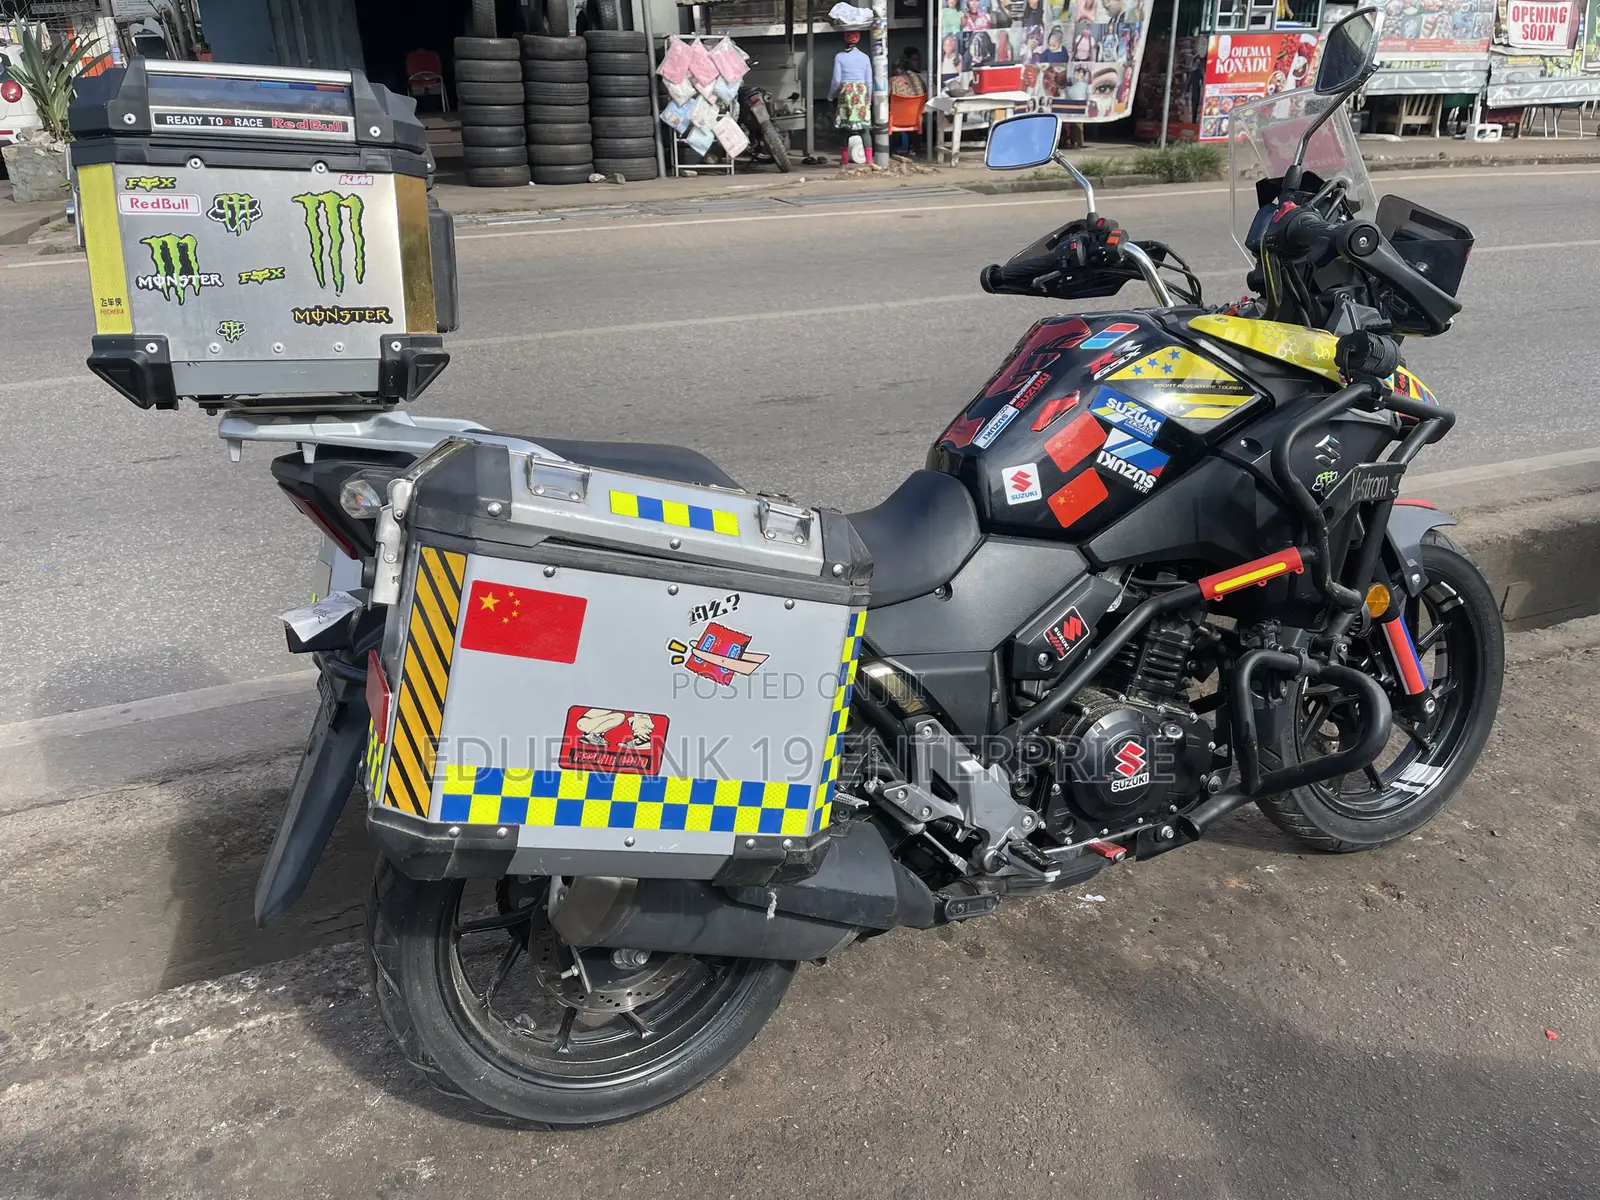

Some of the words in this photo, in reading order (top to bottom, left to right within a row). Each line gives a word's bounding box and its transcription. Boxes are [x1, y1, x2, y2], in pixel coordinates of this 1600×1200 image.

[1512, 5, 1568, 24] OPENING
[1521, 25, 1556, 42] SOON
[1231, 45, 1272, 57] OHEMAA
[1215, 57, 1272, 74] KONADU
[166, 115, 203, 125] READY
[208, 116, 223, 126] TO
[234, 117, 263, 127] RACE
[271, 117, 343, 132] RedBull
[339, 174, 374, 185] KTM
[130, 197, 189, 210] RedBull
[137, 273, 223, 290] MONSTER
[293, 307, 390, 325] MONSTER
[1015, 372, 1050, 409] SUZUKI
[1106, 397, 1162, 432] SUZUKI
[982, 414, 1009, 440] SUZUKI
[1096, 450, 1157, 489] SUZUKI
[1011, 489, 1038, 501] SUZUKI
[1133, 482, 1149, 493] TEAM
[1053, 626, 1071, 652] SUZUKI
[1112, 774, 1149, 792] SUZUKI
